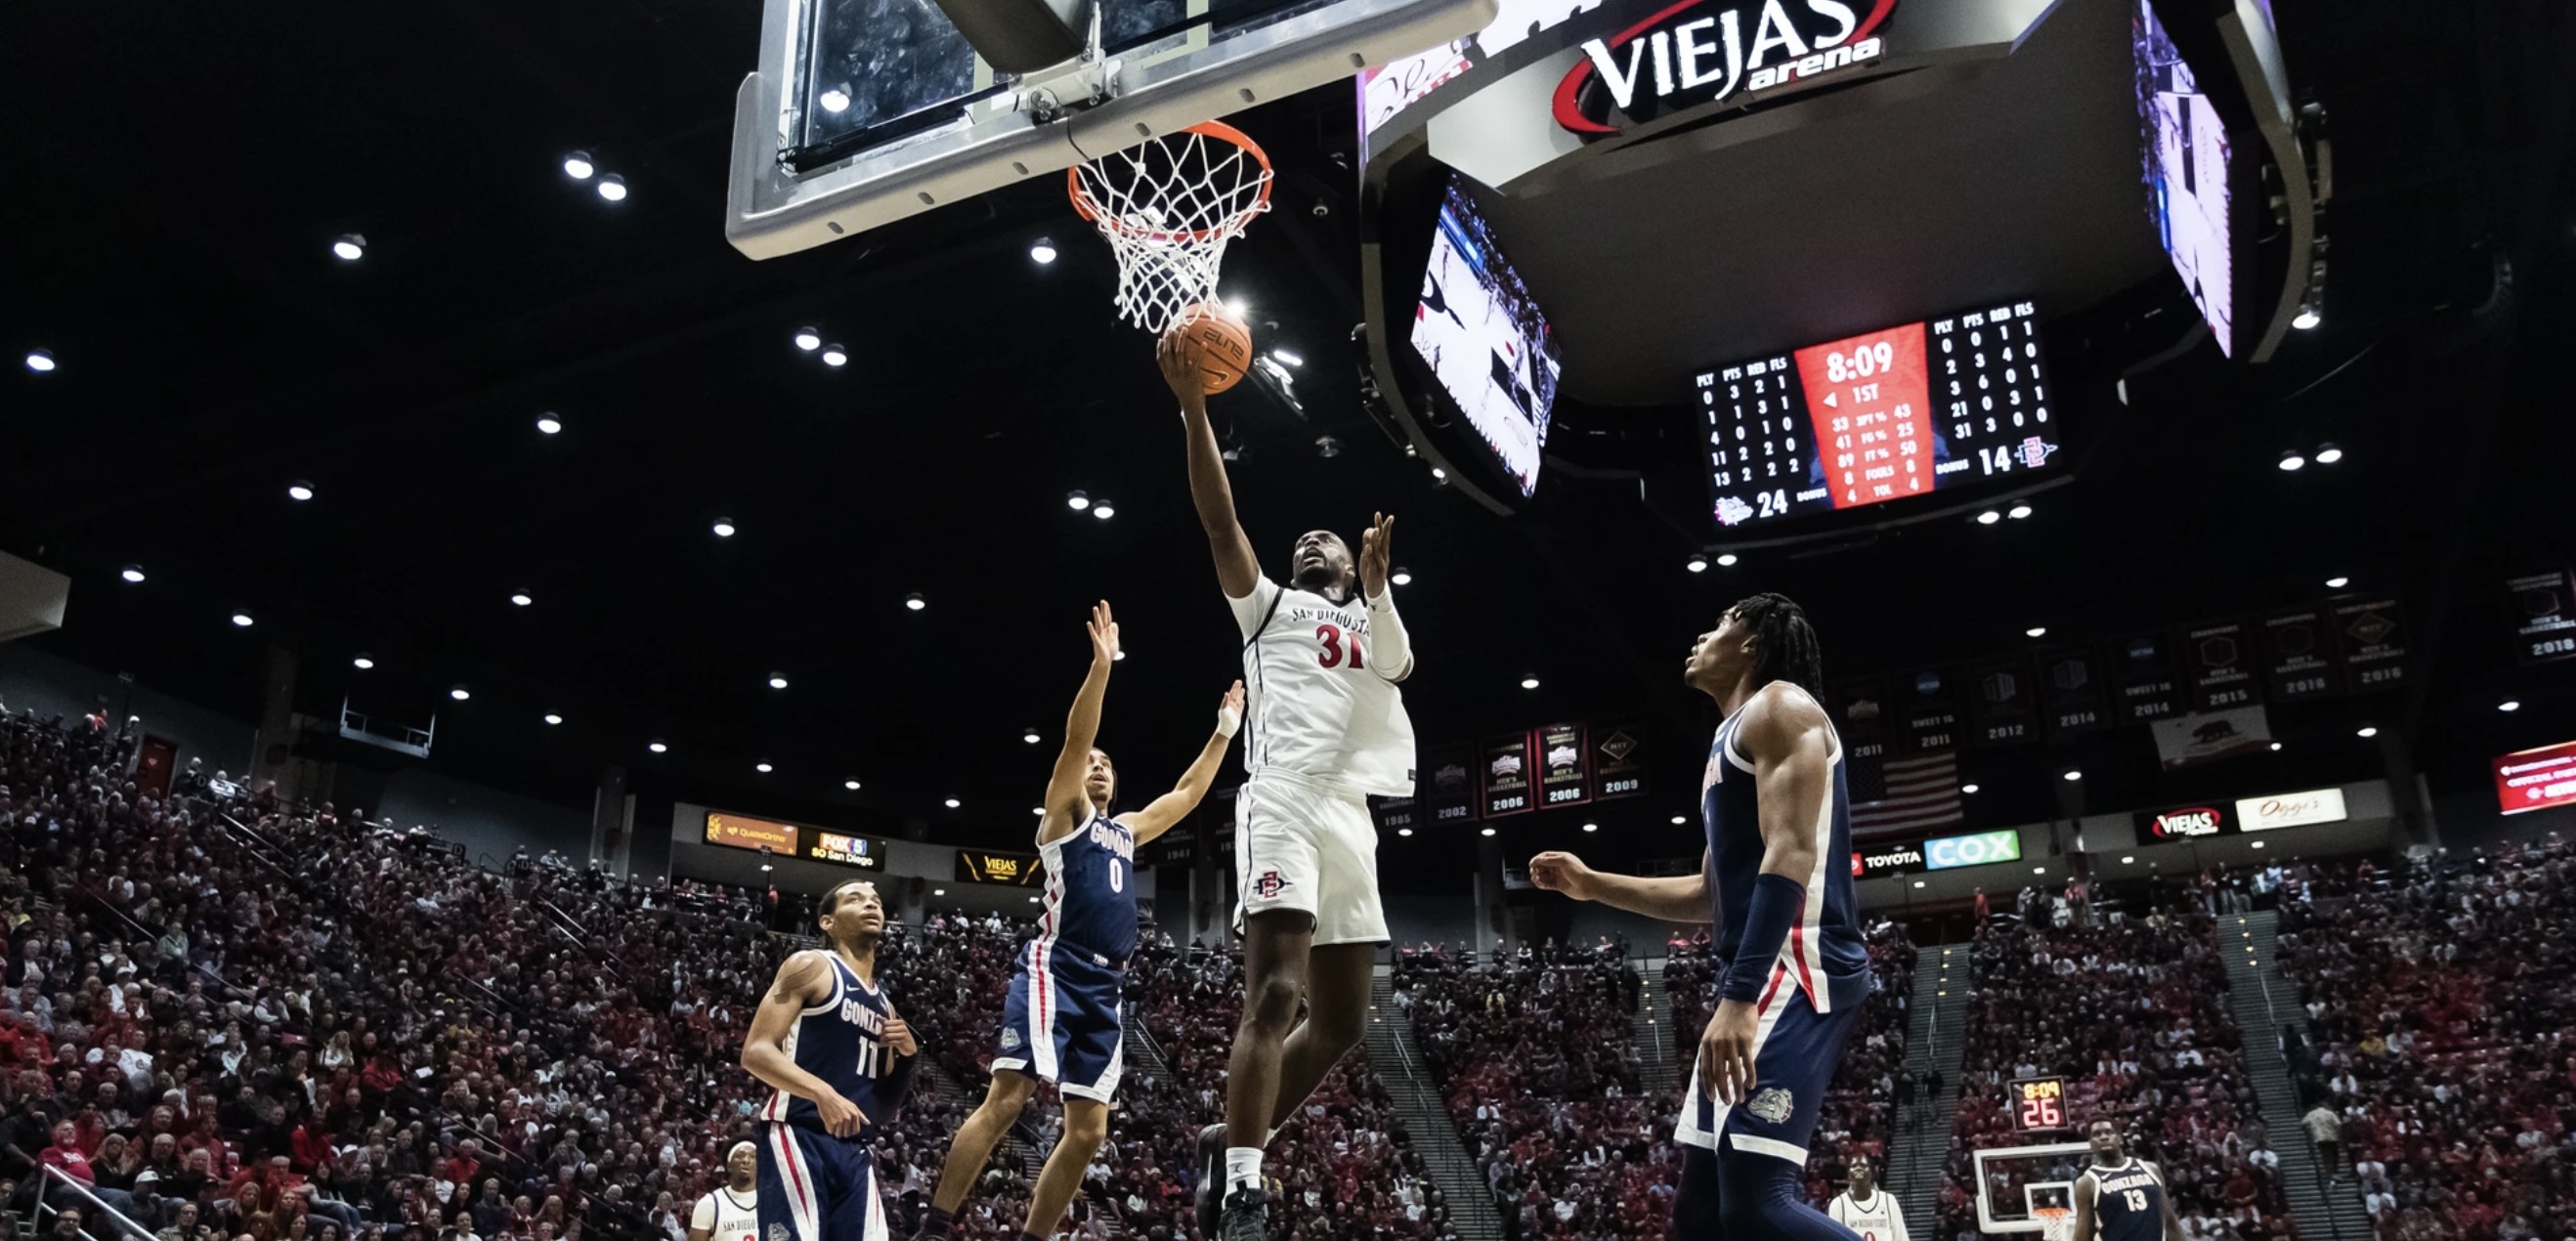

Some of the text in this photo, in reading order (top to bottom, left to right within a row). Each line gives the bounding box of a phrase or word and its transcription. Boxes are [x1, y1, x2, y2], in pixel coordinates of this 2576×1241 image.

[1580, 0, 1857, 108] VIEJAS
[1748, 36, 1881, 92] arena
[1934, 302, 2034, 334] PLY PTS REB FLS
[1203, 326, 1244, 361] ELITE
[1942, 321, 2032, 353] 0 0 1 1
[1826, 342, 1893, 384] 8:09
[1947, 343, 2036, 374] 2 3 4 0
[1696, 358, 1787, 387] PLY PTS REB FLS
[1951, 364, 2039, 395] 3 6 0 1
[1703, 375, 1784, 405] 0 3 2 1
[1853, 383, 1878, 403] 1ST
[1952, 386, 2042, 417] 21 0 3 1
[1708, 396, 1788, 424] 1 1 3 1
[1832, 404, 1911, 432] 33 3PT % 43
[1955, 407, 2047, 439] 31 3 0 0
[1711, 417, 1791, 445] 4 0 1 0
[1836, 422, 1913, 449] 41 FG % 25
[1712, 438, 1795, 466] 11 2 2 0
[1838, 441, 1916, 468] 89 FT % 50
[1936, 446, 2011, 475] BONUS 14
[1714, 458, 1798, 487] 13 2 2 2
[1845, 459, 1915, 485] 8 FOULS 8
[1757, 488, 1827, 518] 24 BONUS
[1848, 477, 1918, 502] 4 TOL 4
[1292, 608, 1313, 621] SAN
[1316, 624, 1364, 669] 31
[2125, 684, 2157, 697] SWEET
[2210, 689, 2248, 706] 2015
[1911, 714, 1954, 729] SWEET 16
[2059, 711, 2095, 727] 2014
[2134, 701, 2169, 717] 2014
[1921, 733, 1952, 748] 2011
[1989, 724, 2025, 740] 2012
[1855, 744, 1883, 757] 2011
[1549, 788, 1580, 802] 2006
[1605, 779, 1639, 793] 2009
[1438, 805, 1468, 819] 2002
[1493, 796, 1524, 811] 2006
[1385, 814, 1412, 827] 1985
[2157, 812, 2214, 835] VIEJAS
[823, 834, 863, 855] FOX 5
[1932, 831, 2014, 866] COX
[828, 850, 844, 861] San
[846, 854, 874, 867] Diego
[984, 855, 1017, 872] VIEJAS
[1865, 851, 1921, 868] TOYOTA
[1109, 858, 1123, 893] 0
[841, 998, 883, 1036] GONZA
[856, 1036, 878, 1079] 11
[2023, 1081, 2060, 1099] 8:09
[2023, 1097, 2060, 1127] 26
[2101, 1174, 2155, 1194] GONZAGA
[2123, 1189, 2148, 1212] 13
[723, 1219, 756, 1232] SAN DIEGO
